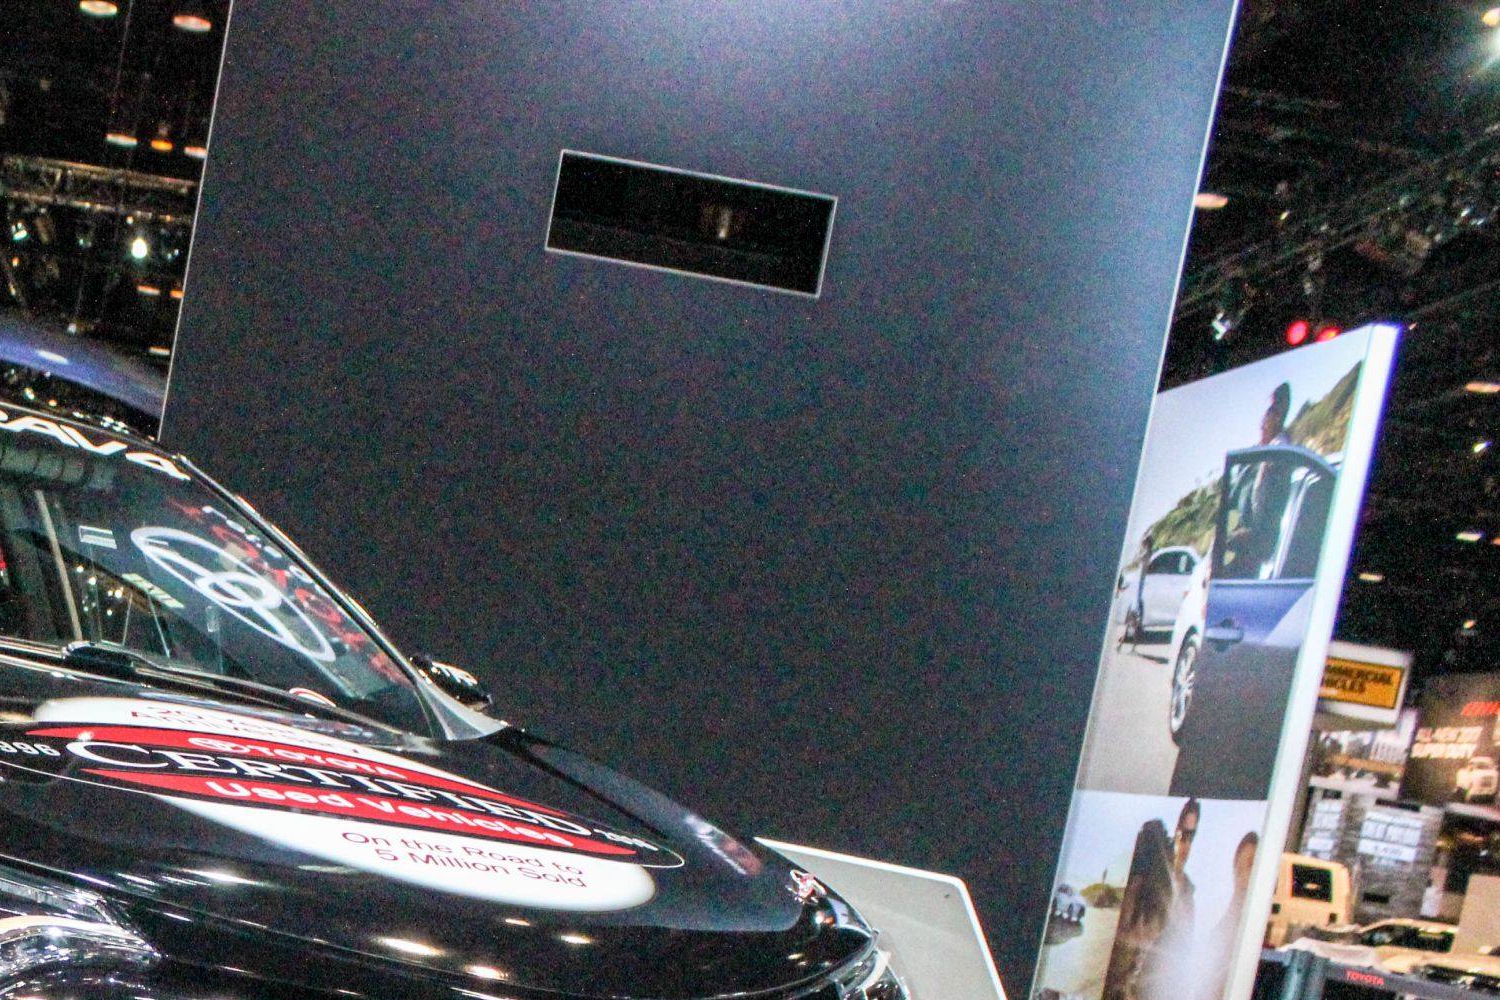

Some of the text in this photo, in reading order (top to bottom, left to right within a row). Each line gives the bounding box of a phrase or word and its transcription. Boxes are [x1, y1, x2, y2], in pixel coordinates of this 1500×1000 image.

[248, 745, 408, 779] TOYOTA
[66, 741, 592, 837] CERTIFIED
[205, 781, 575, 847] Used Vehicles
[341, 831, 583, 876] On the Road to
[373, 848, 587, 889] 5 Million Sold
[1345, 969, 1386, 987] TOYOTA
